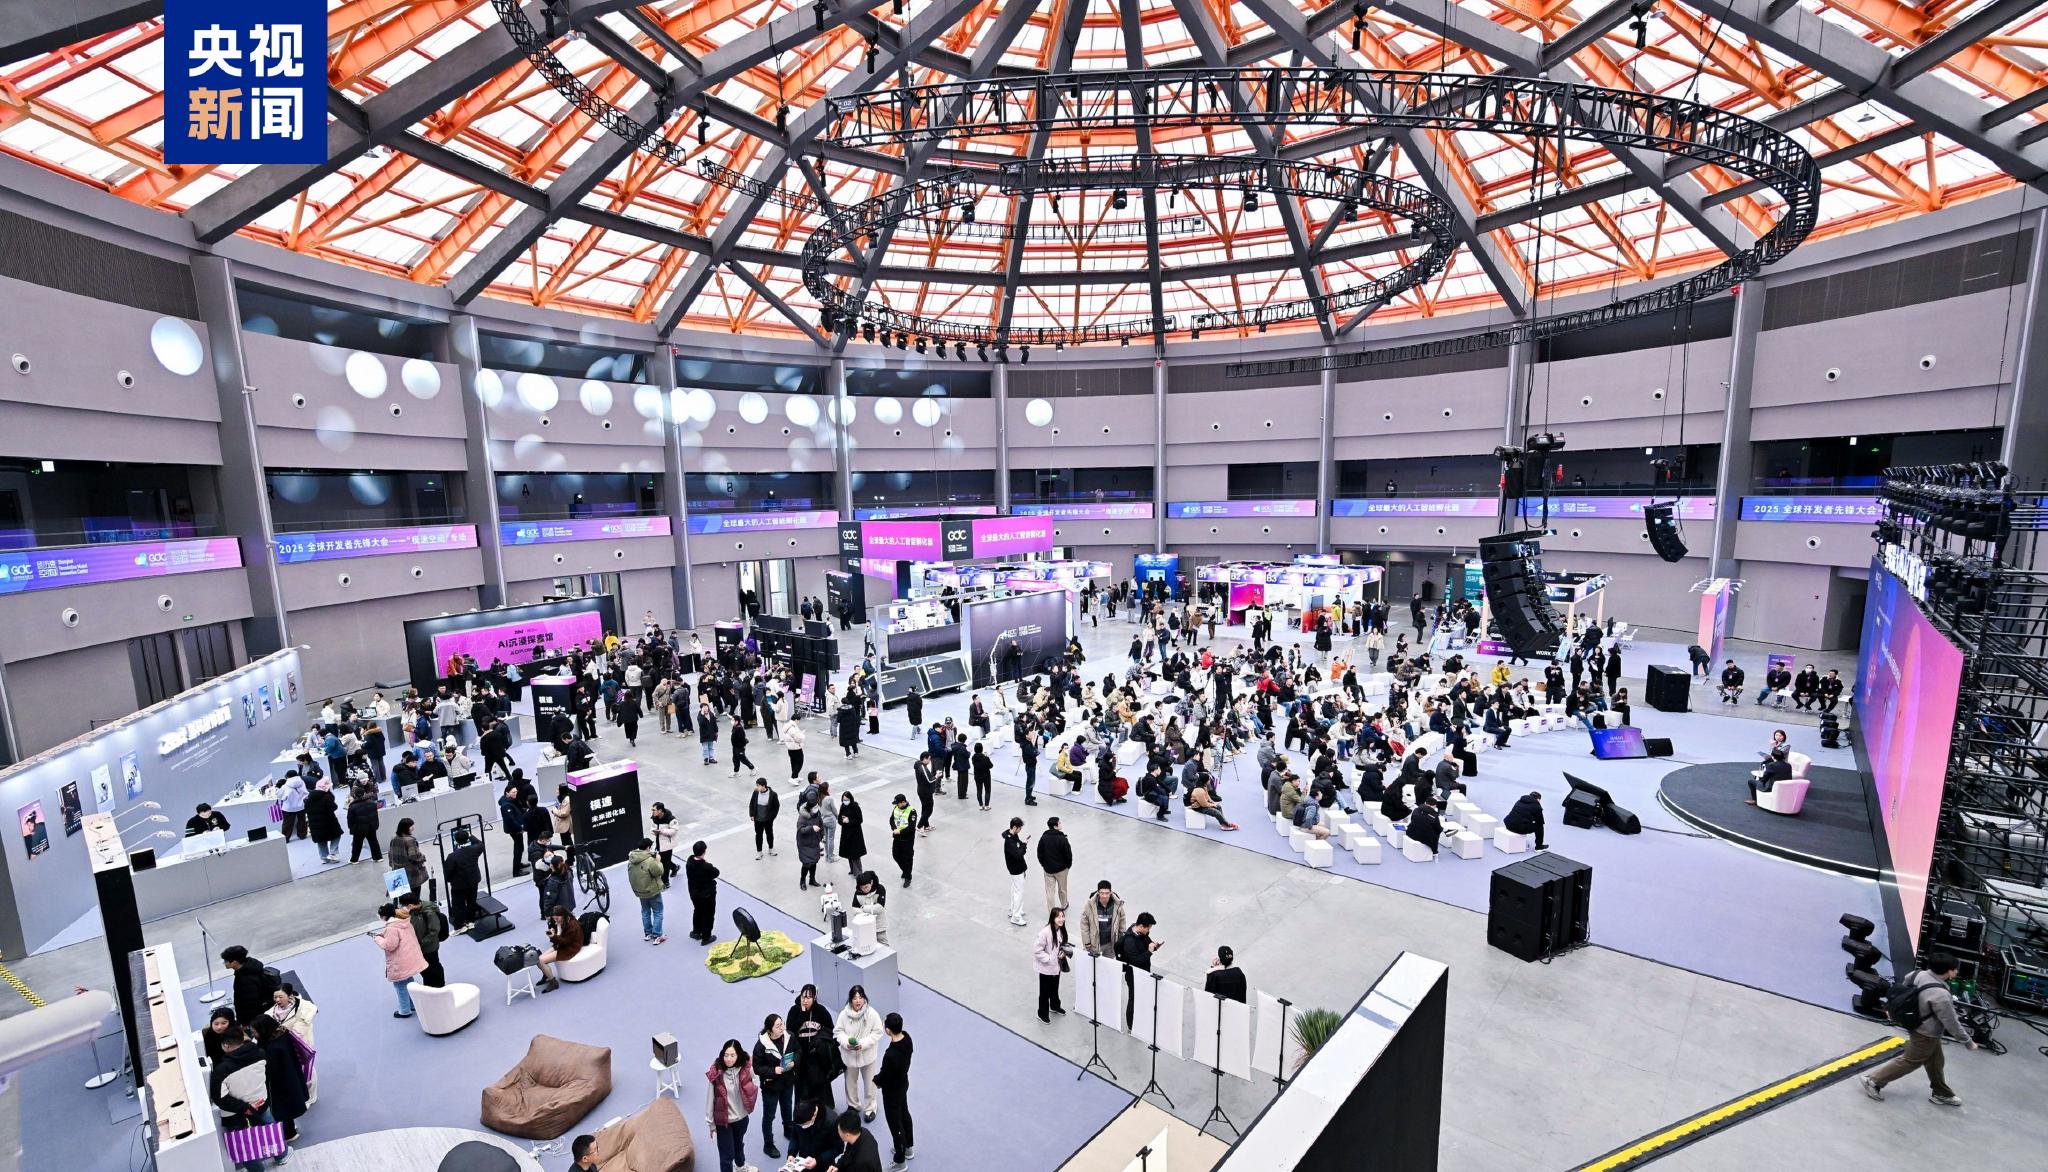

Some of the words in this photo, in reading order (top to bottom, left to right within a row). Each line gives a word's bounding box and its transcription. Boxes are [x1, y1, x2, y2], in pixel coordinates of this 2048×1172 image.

[1754, 505, 1779, 513] 2025
[279, 544, 304, 554] 2025
[1266, 574, 1277, 583] B3
